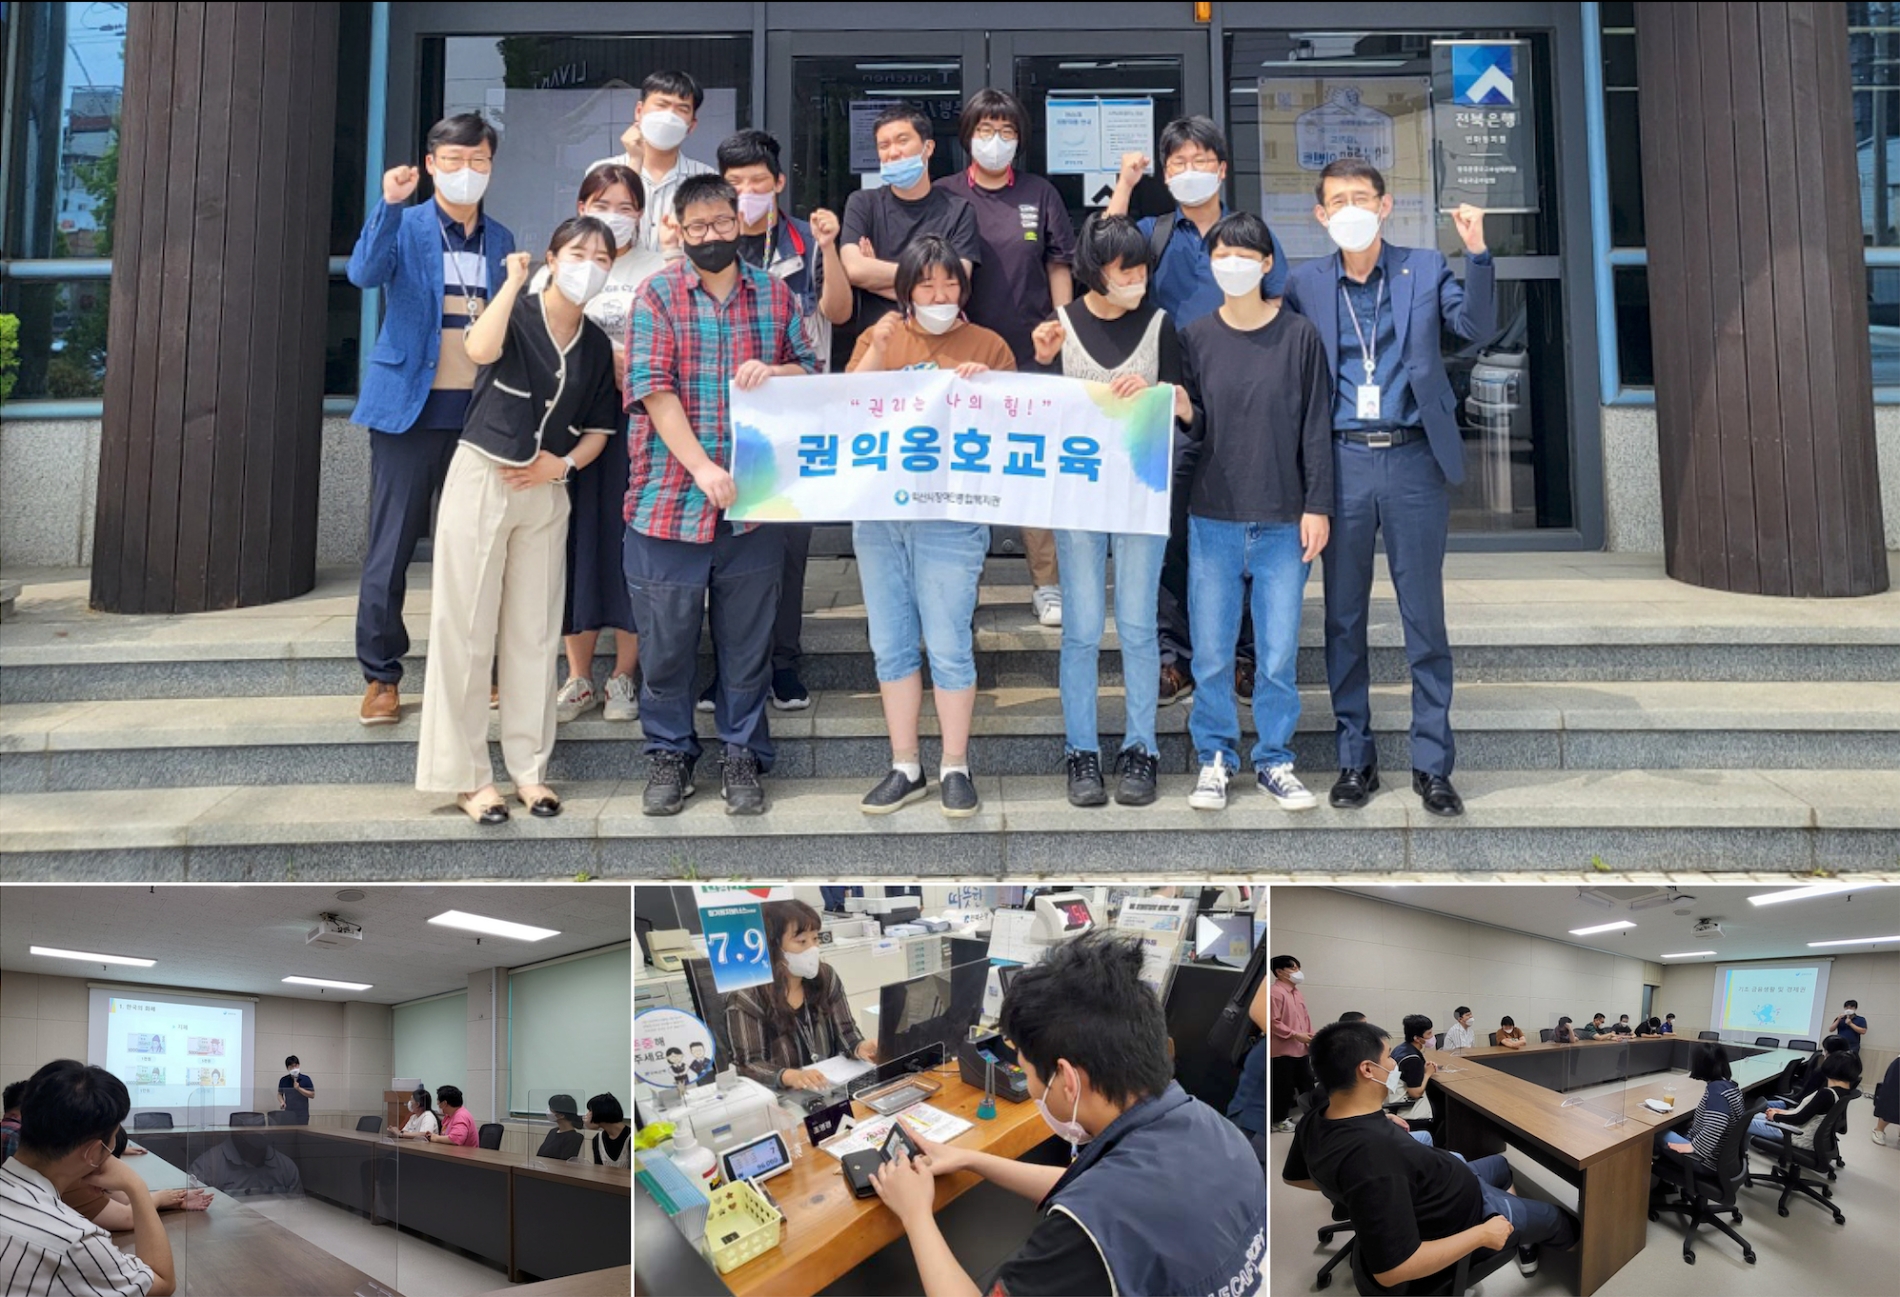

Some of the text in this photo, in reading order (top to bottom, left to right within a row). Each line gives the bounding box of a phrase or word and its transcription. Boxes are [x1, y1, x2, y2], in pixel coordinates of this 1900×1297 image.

[1456, 112, 1516, 128] 전북은행
[945, 393, 983, 411] 나의
[797, 425, 1102, 482] 권익옹호교육
[708, 928, 766, 964] 7.9
